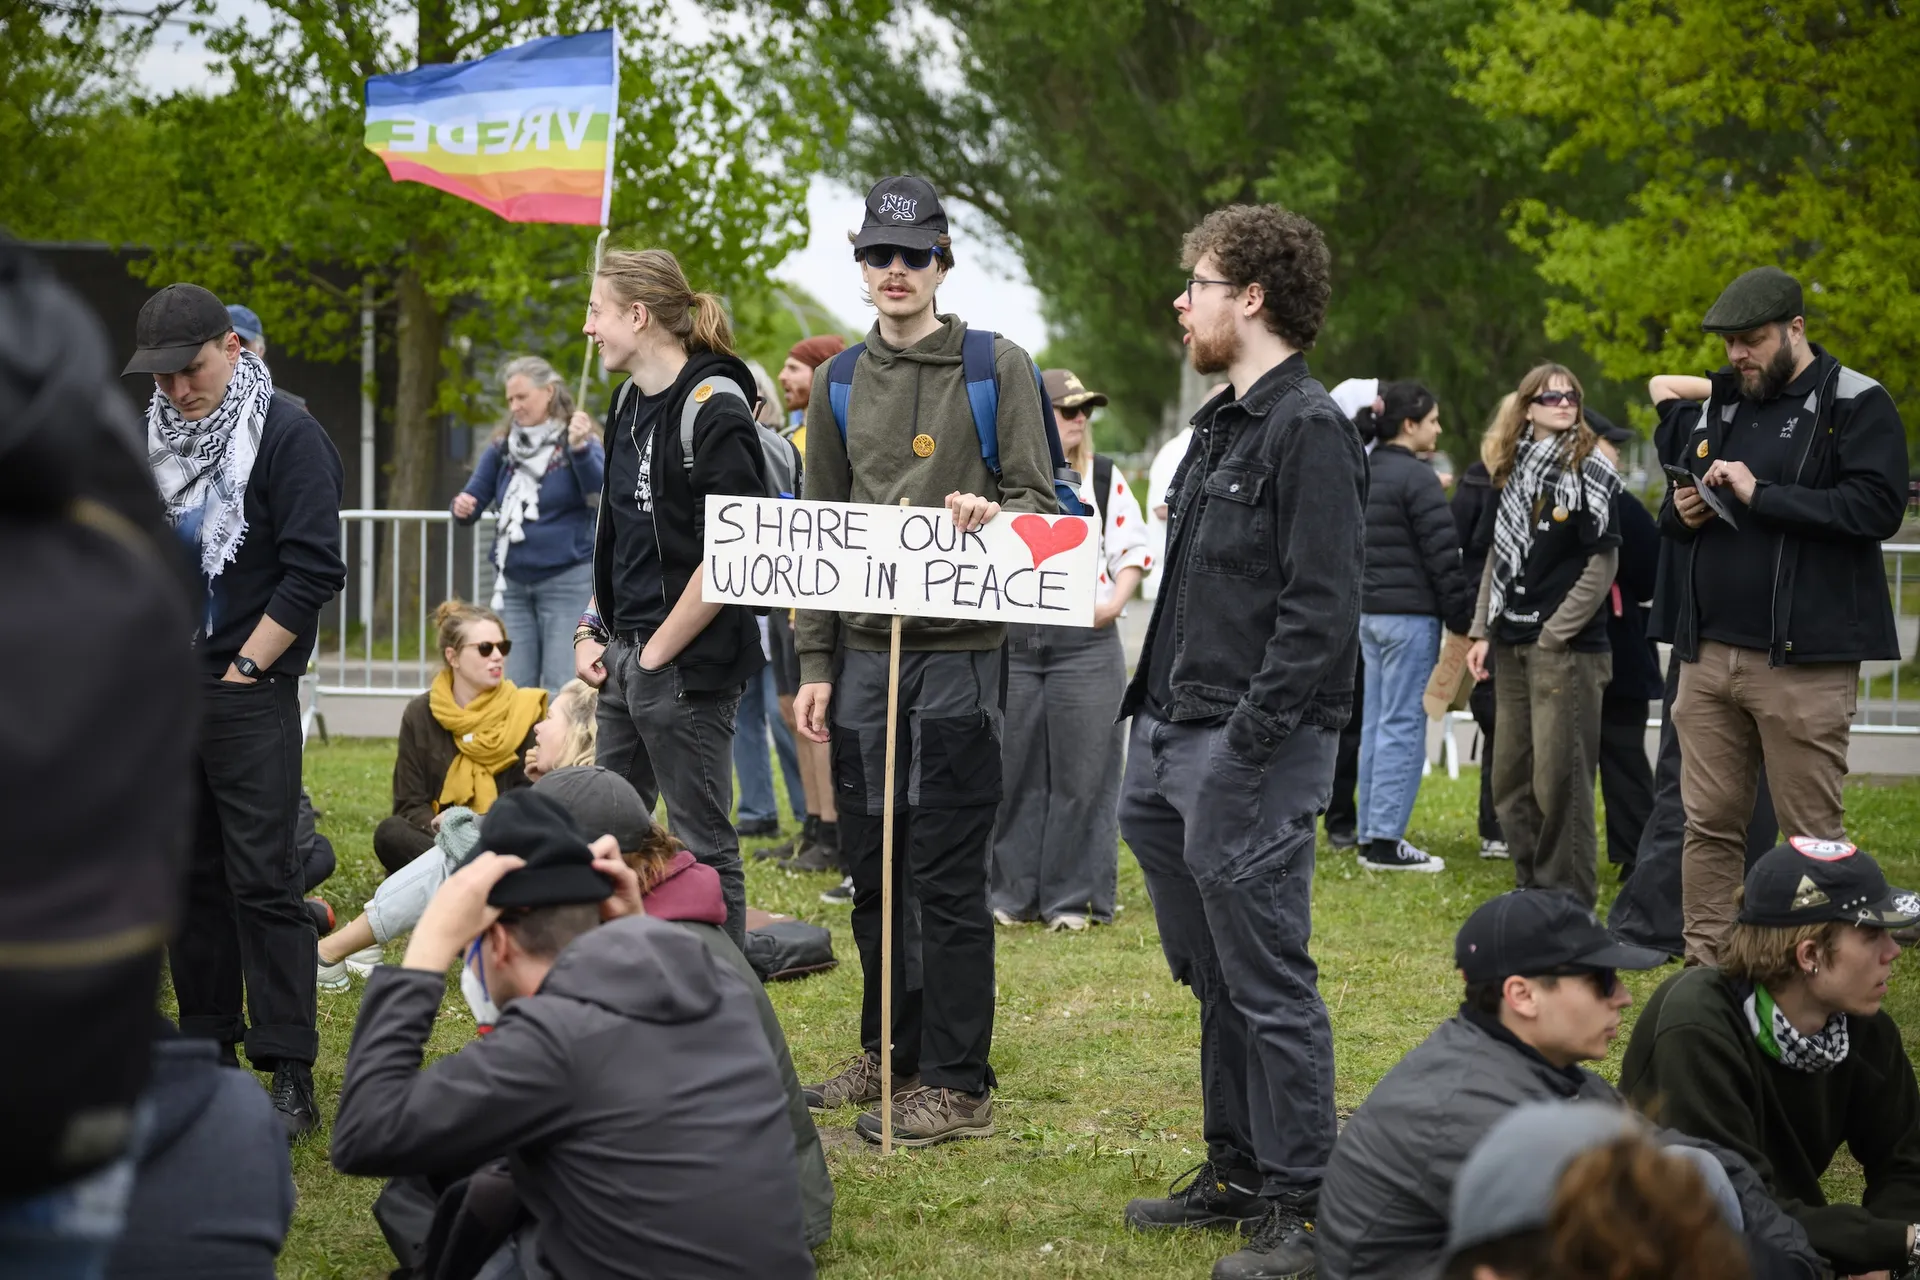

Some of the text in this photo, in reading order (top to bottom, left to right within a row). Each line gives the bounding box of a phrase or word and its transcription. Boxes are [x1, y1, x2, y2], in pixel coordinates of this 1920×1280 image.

[714, 502, 988, 555] SHARE OUR
[711, 553, 841, 598] WORLD
[922, 558, 1071, 611] PEACE
